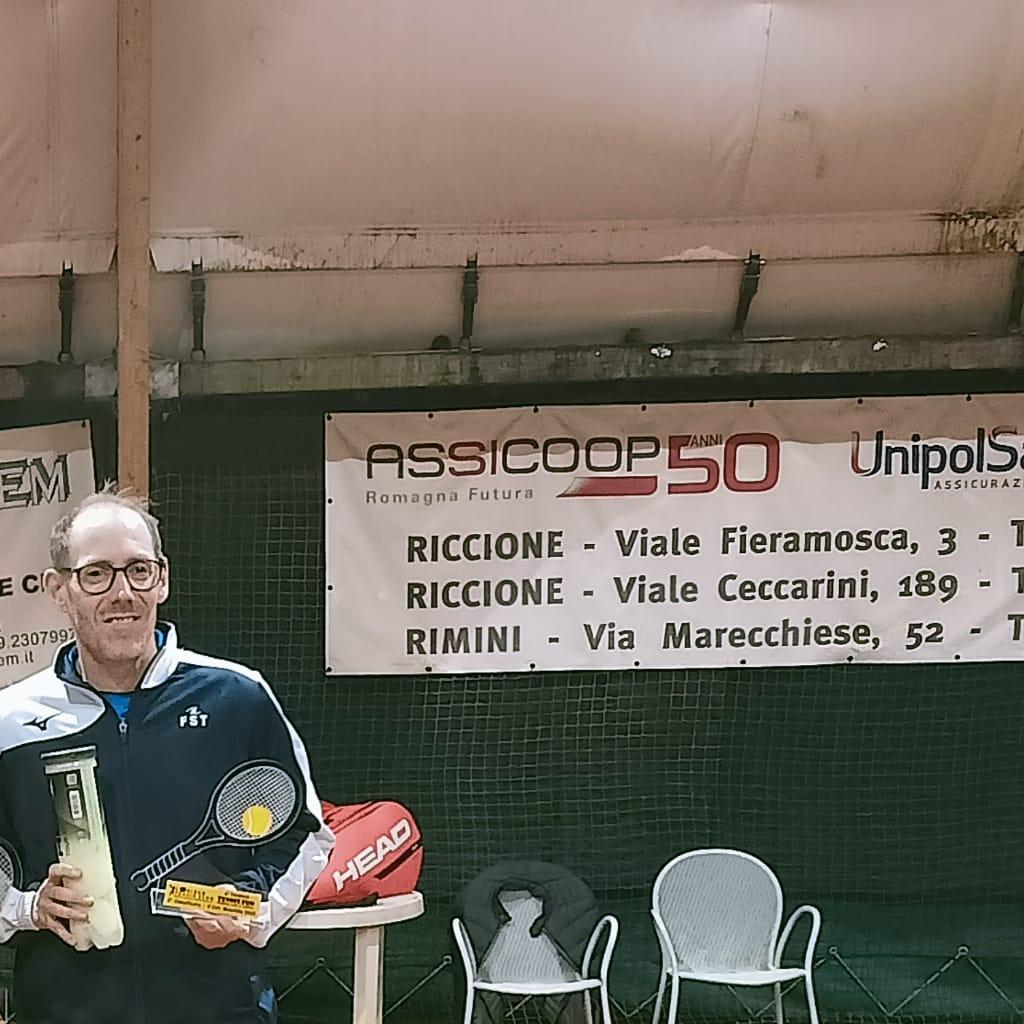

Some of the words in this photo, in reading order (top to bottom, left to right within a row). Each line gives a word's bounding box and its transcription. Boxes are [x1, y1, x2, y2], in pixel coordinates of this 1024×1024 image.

[690, 433, 723, 448] ANNI
[851, 425, 1024, 490] UnipolS
[366, 436, 661, 478] ASSICOOP
[667, 432, 780, 494] 50
[366, 490, 458, 506] Romagna
[468, 486, 534, 502] Futura
[934, 477, 1024, 490] ASSICURAZ
[407, 531, 564, 563] RICCIONE
[615, 527, 700, 558] Viale
[721, 525, 919, 555] Fieramosca,
[937, 527, 957, 556] 3
[22, 573, 45, 594] C
[407, 577, 564, 609] RICCIONE
[613, 574, 698, 604] Viale
[718, 569, 879, 602] Ceccarini,
[898, 571, 958, 602] 189
[406, 625, 521, 655] RIMINI
[583, 622, 635, 650] Via
[662, 618, 881, 650] Marecchiese,
[905, 623, 944, 650] 52
[332, 817, 412, 893] HEAD
